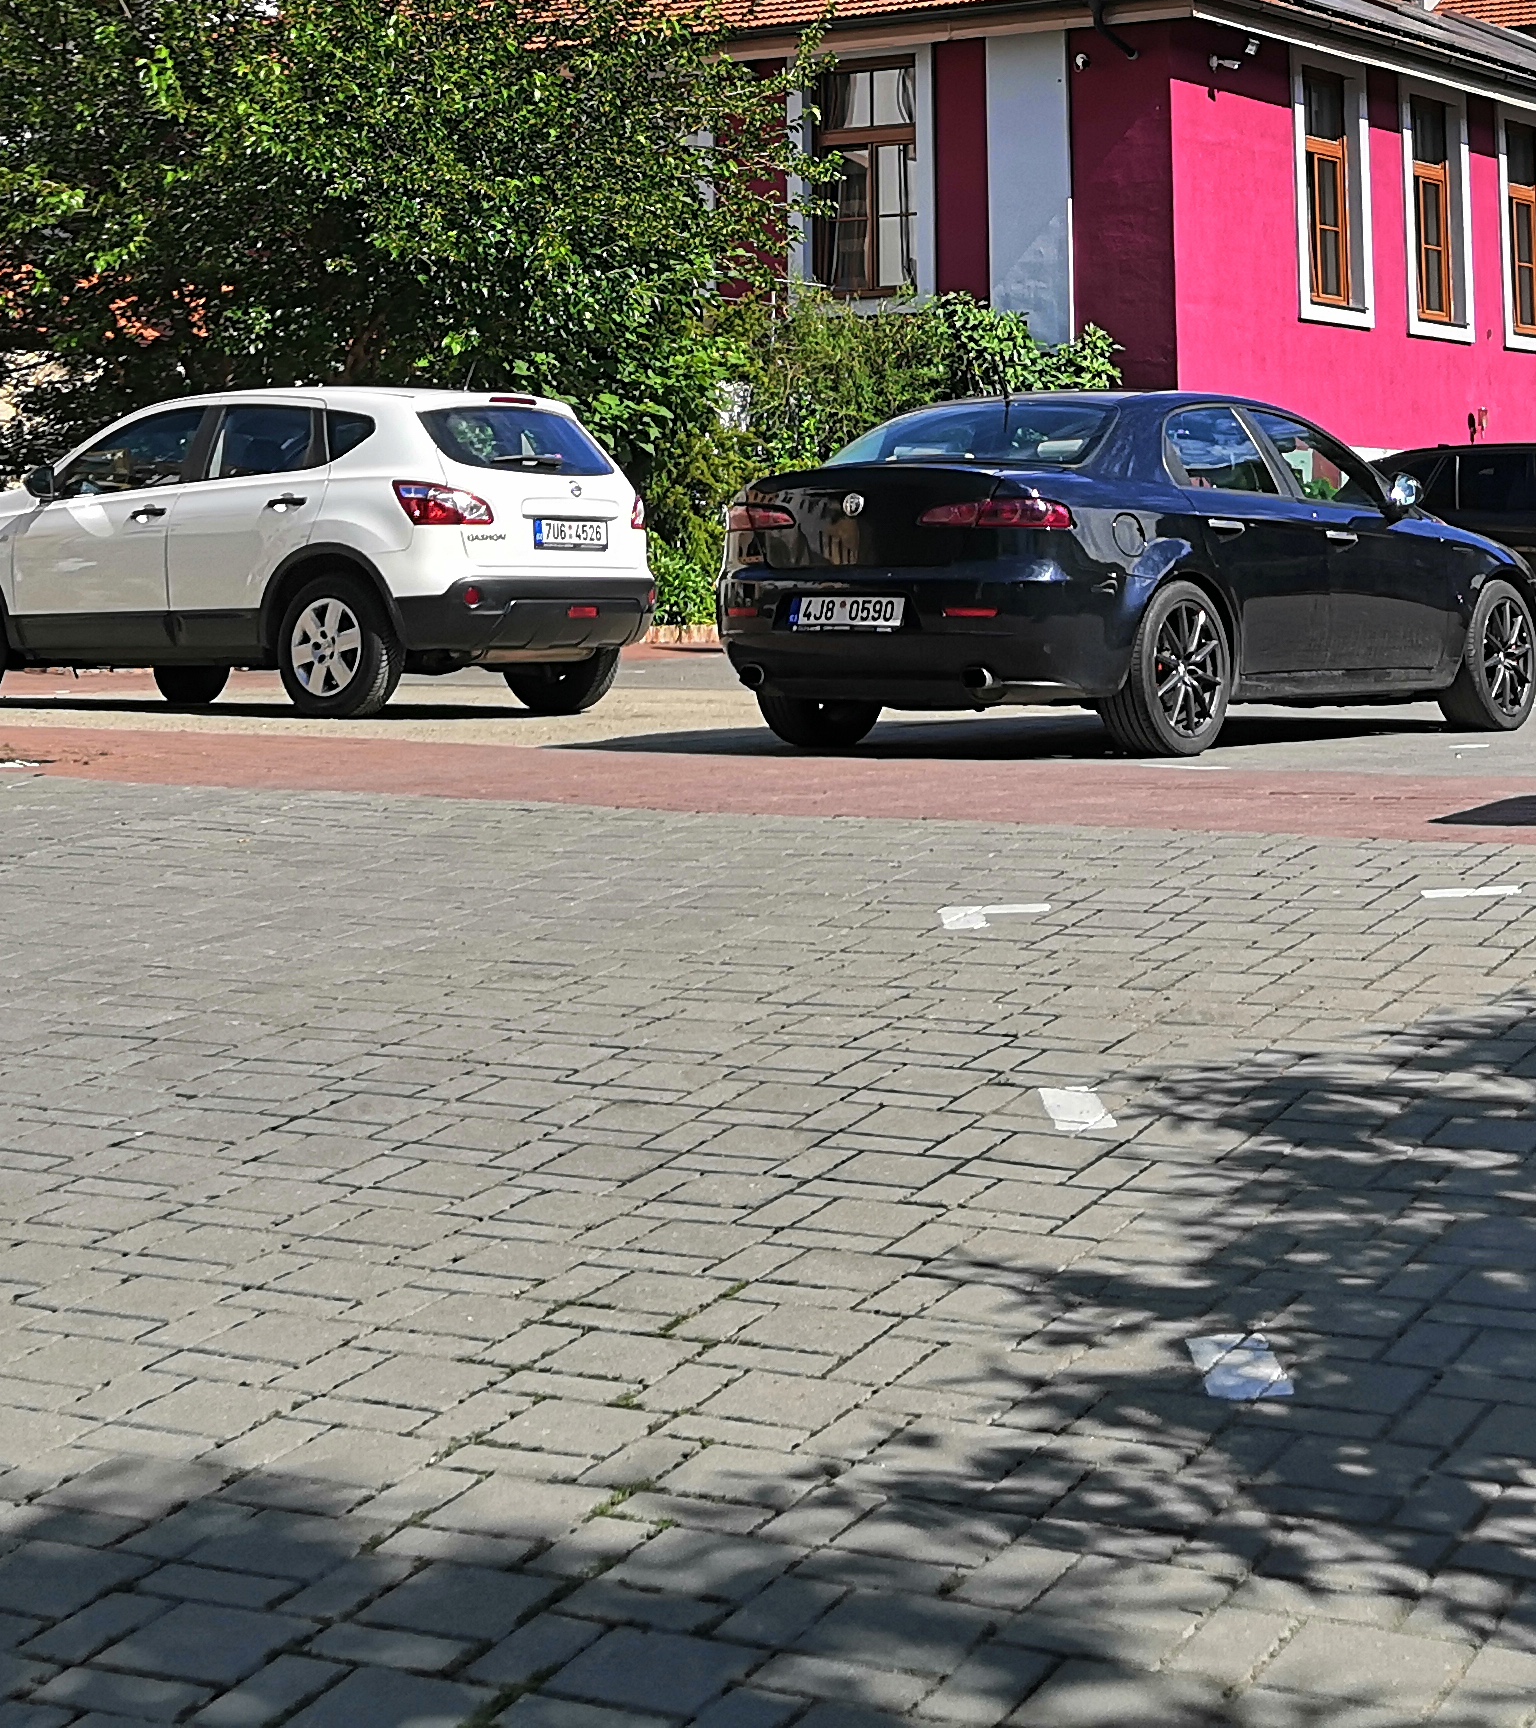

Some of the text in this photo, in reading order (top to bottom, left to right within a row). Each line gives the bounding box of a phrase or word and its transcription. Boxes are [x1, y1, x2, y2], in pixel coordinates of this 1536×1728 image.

[545, 522, 567, 541] 7U6
[575, 523, 602, 542] 4526
[802, 599, 895, 622] 4J8 0590
